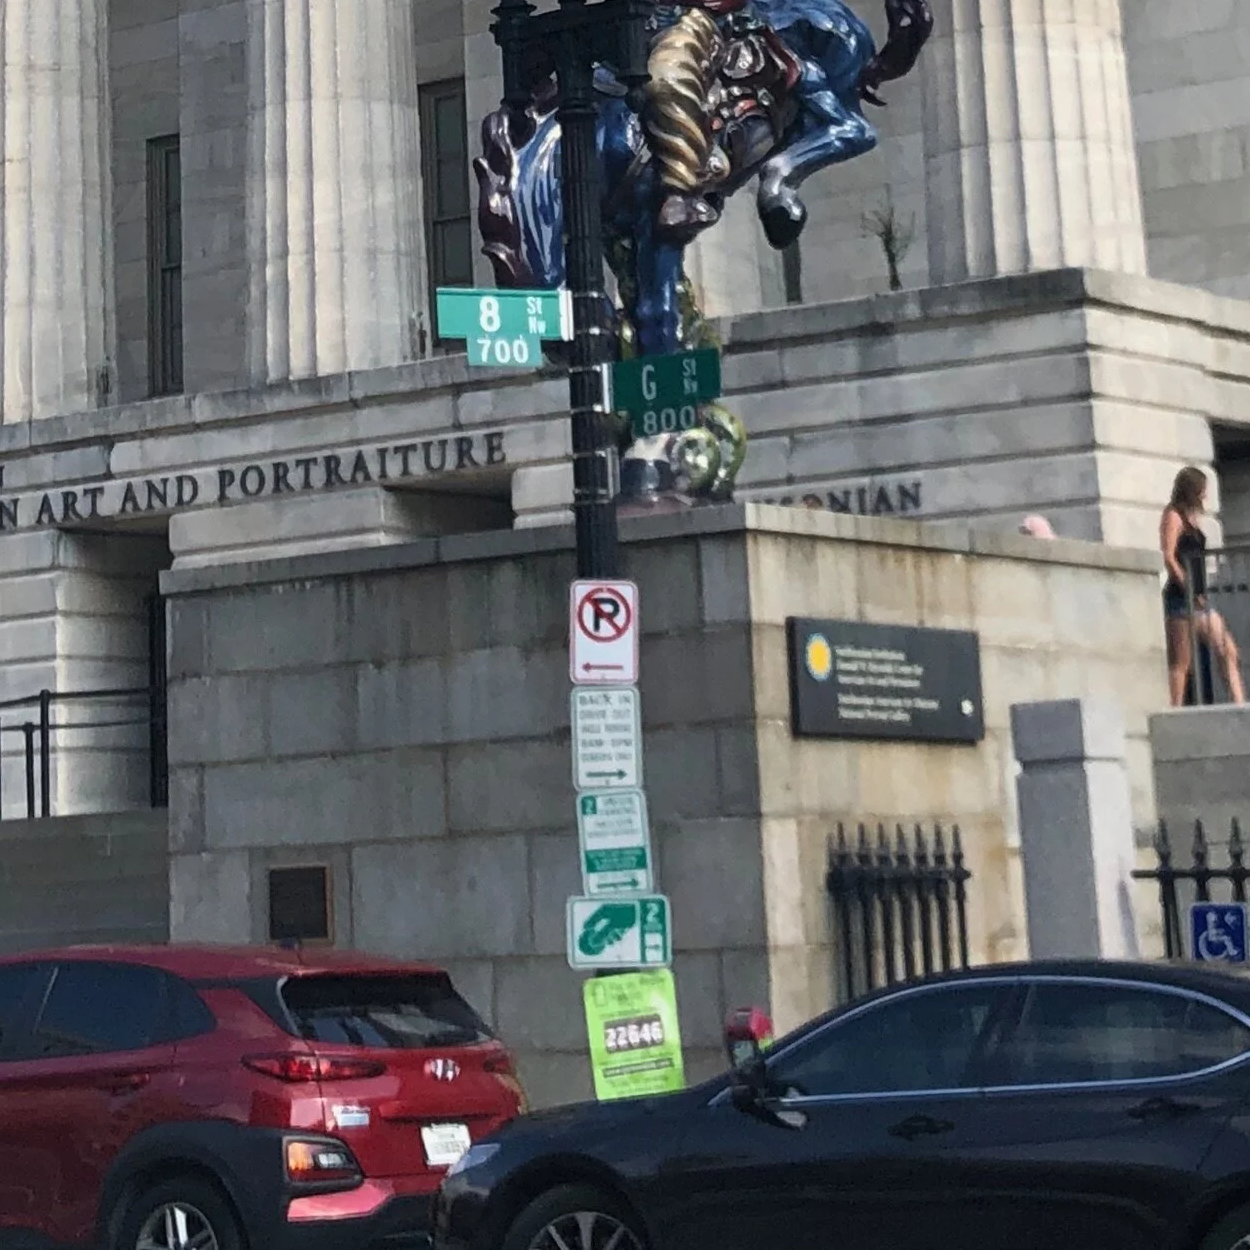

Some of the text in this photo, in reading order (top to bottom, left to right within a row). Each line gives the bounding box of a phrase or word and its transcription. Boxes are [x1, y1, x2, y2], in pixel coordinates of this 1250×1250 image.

[479, 296, 543, 333] 8 St
[477, 338, 528, 364] 700
[642, 358, 697, 401] G St
[643, 405, 696, 435] 800
[35, 487, 104, 525] ART
[119, 474, 199, 515] AND
[217, 431, 507, 502] PORTRAITURE
[646, 902, 659, 922] 2
